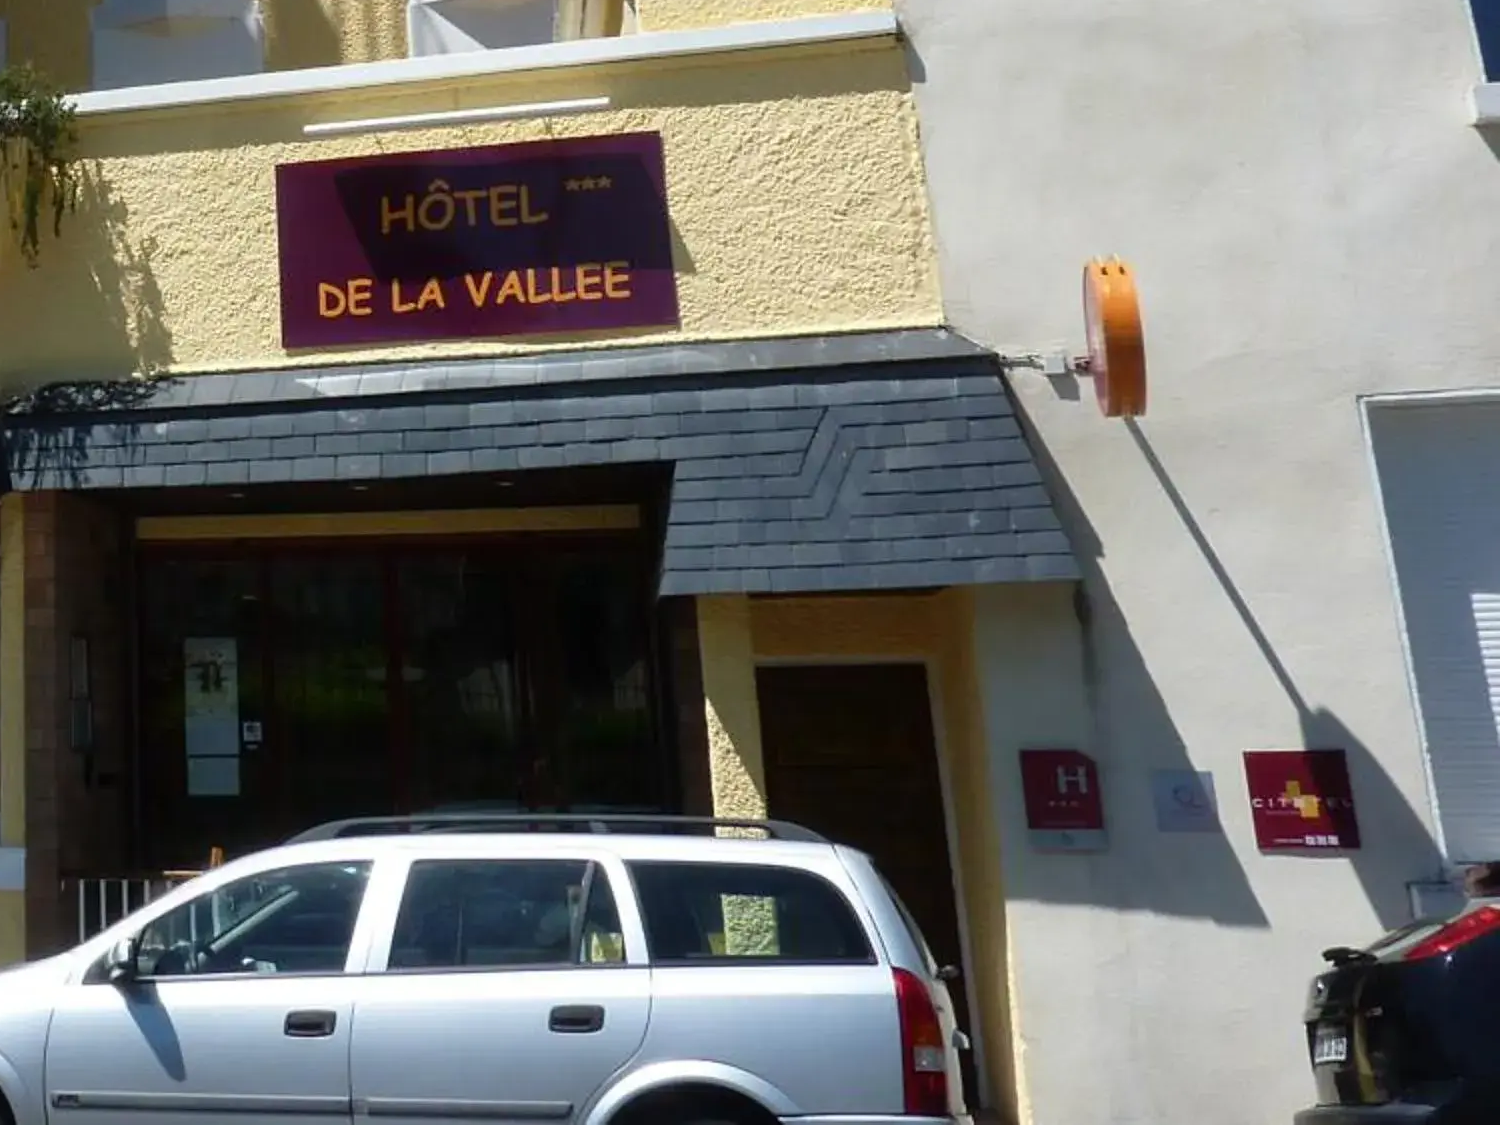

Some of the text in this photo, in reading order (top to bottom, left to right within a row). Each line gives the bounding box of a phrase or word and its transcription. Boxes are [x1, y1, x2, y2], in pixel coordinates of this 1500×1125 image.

[381, 179, 548, 234] HÔTEL
[317, 261, 632, 316] DE LA VALLEE
[1057, 765, 1088, 794] H
